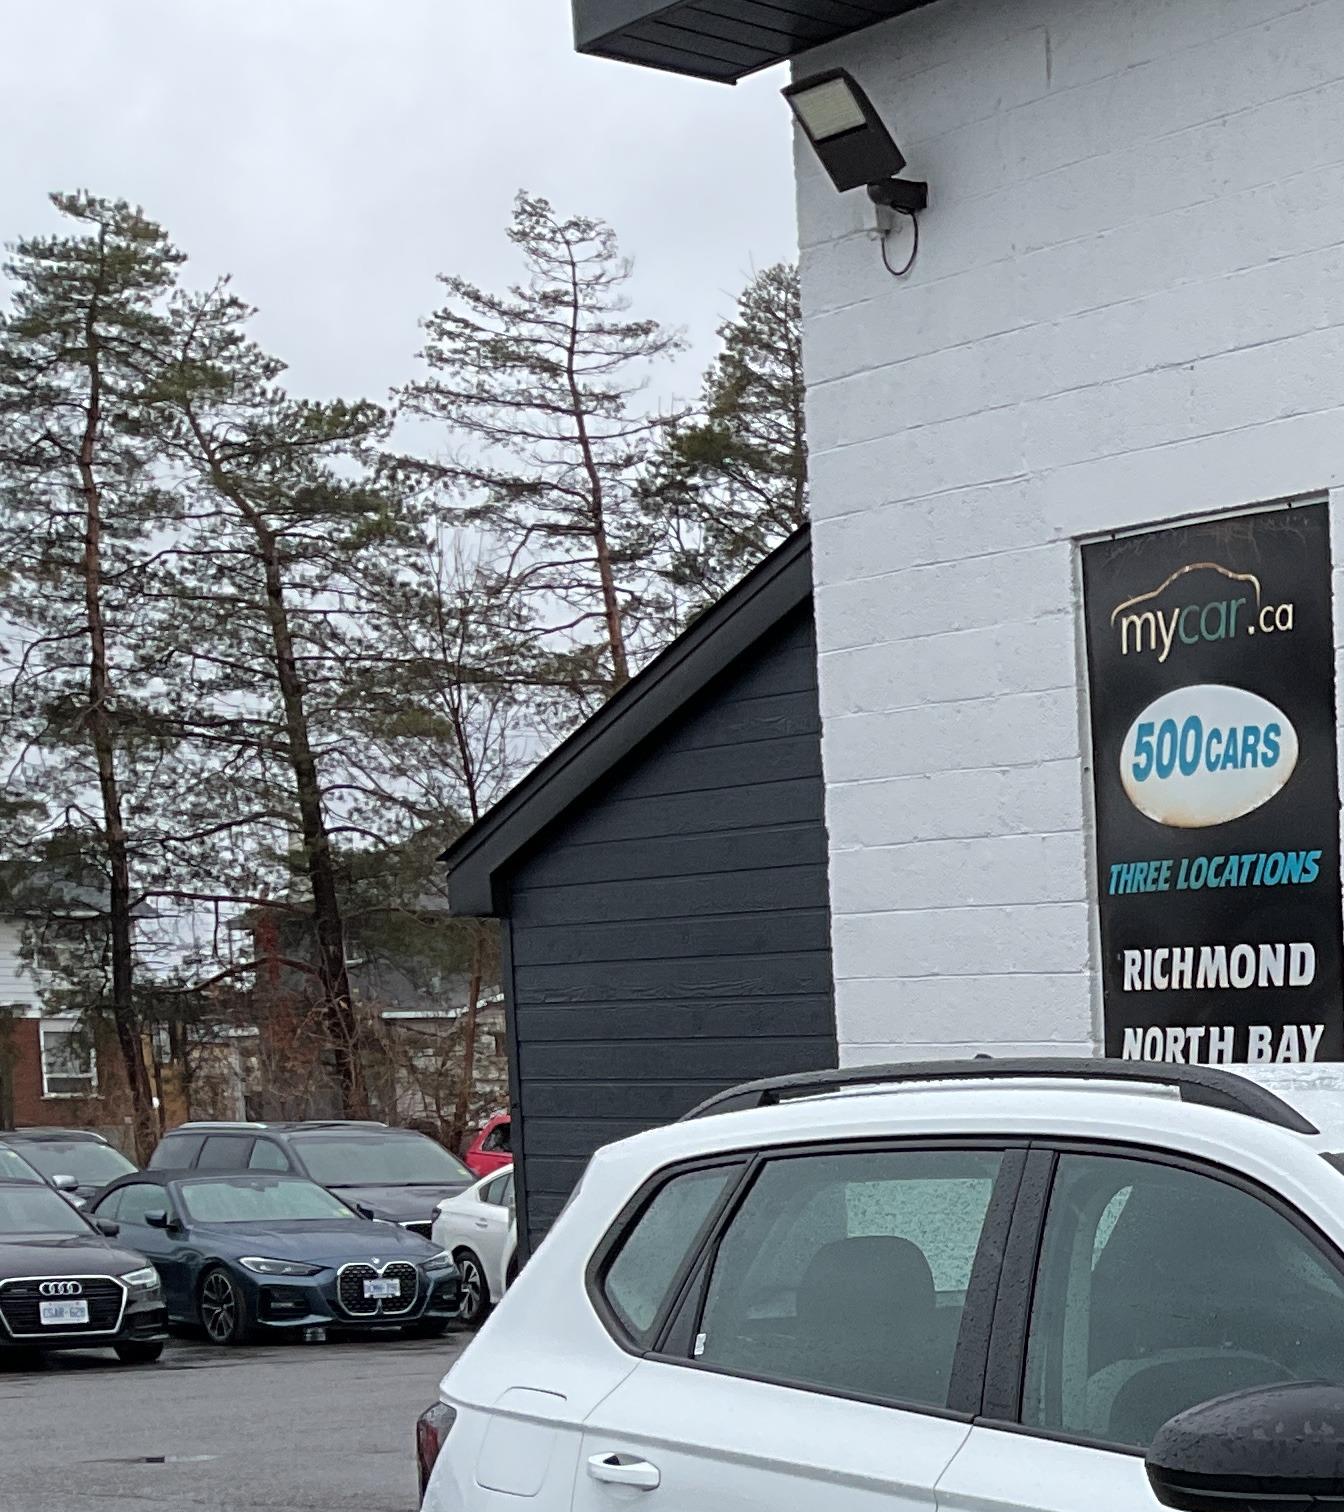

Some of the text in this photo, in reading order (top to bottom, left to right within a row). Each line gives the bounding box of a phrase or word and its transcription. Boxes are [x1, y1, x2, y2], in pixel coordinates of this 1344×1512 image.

[1132, 715, 1282, 782] 500 CARS
[1109, 850, 1323, 896] THREE LOCATIONS
[1123, 942, 1316, 991] RICHMOND
[1122, 1024, 1325, 1065] NORTH BAY
